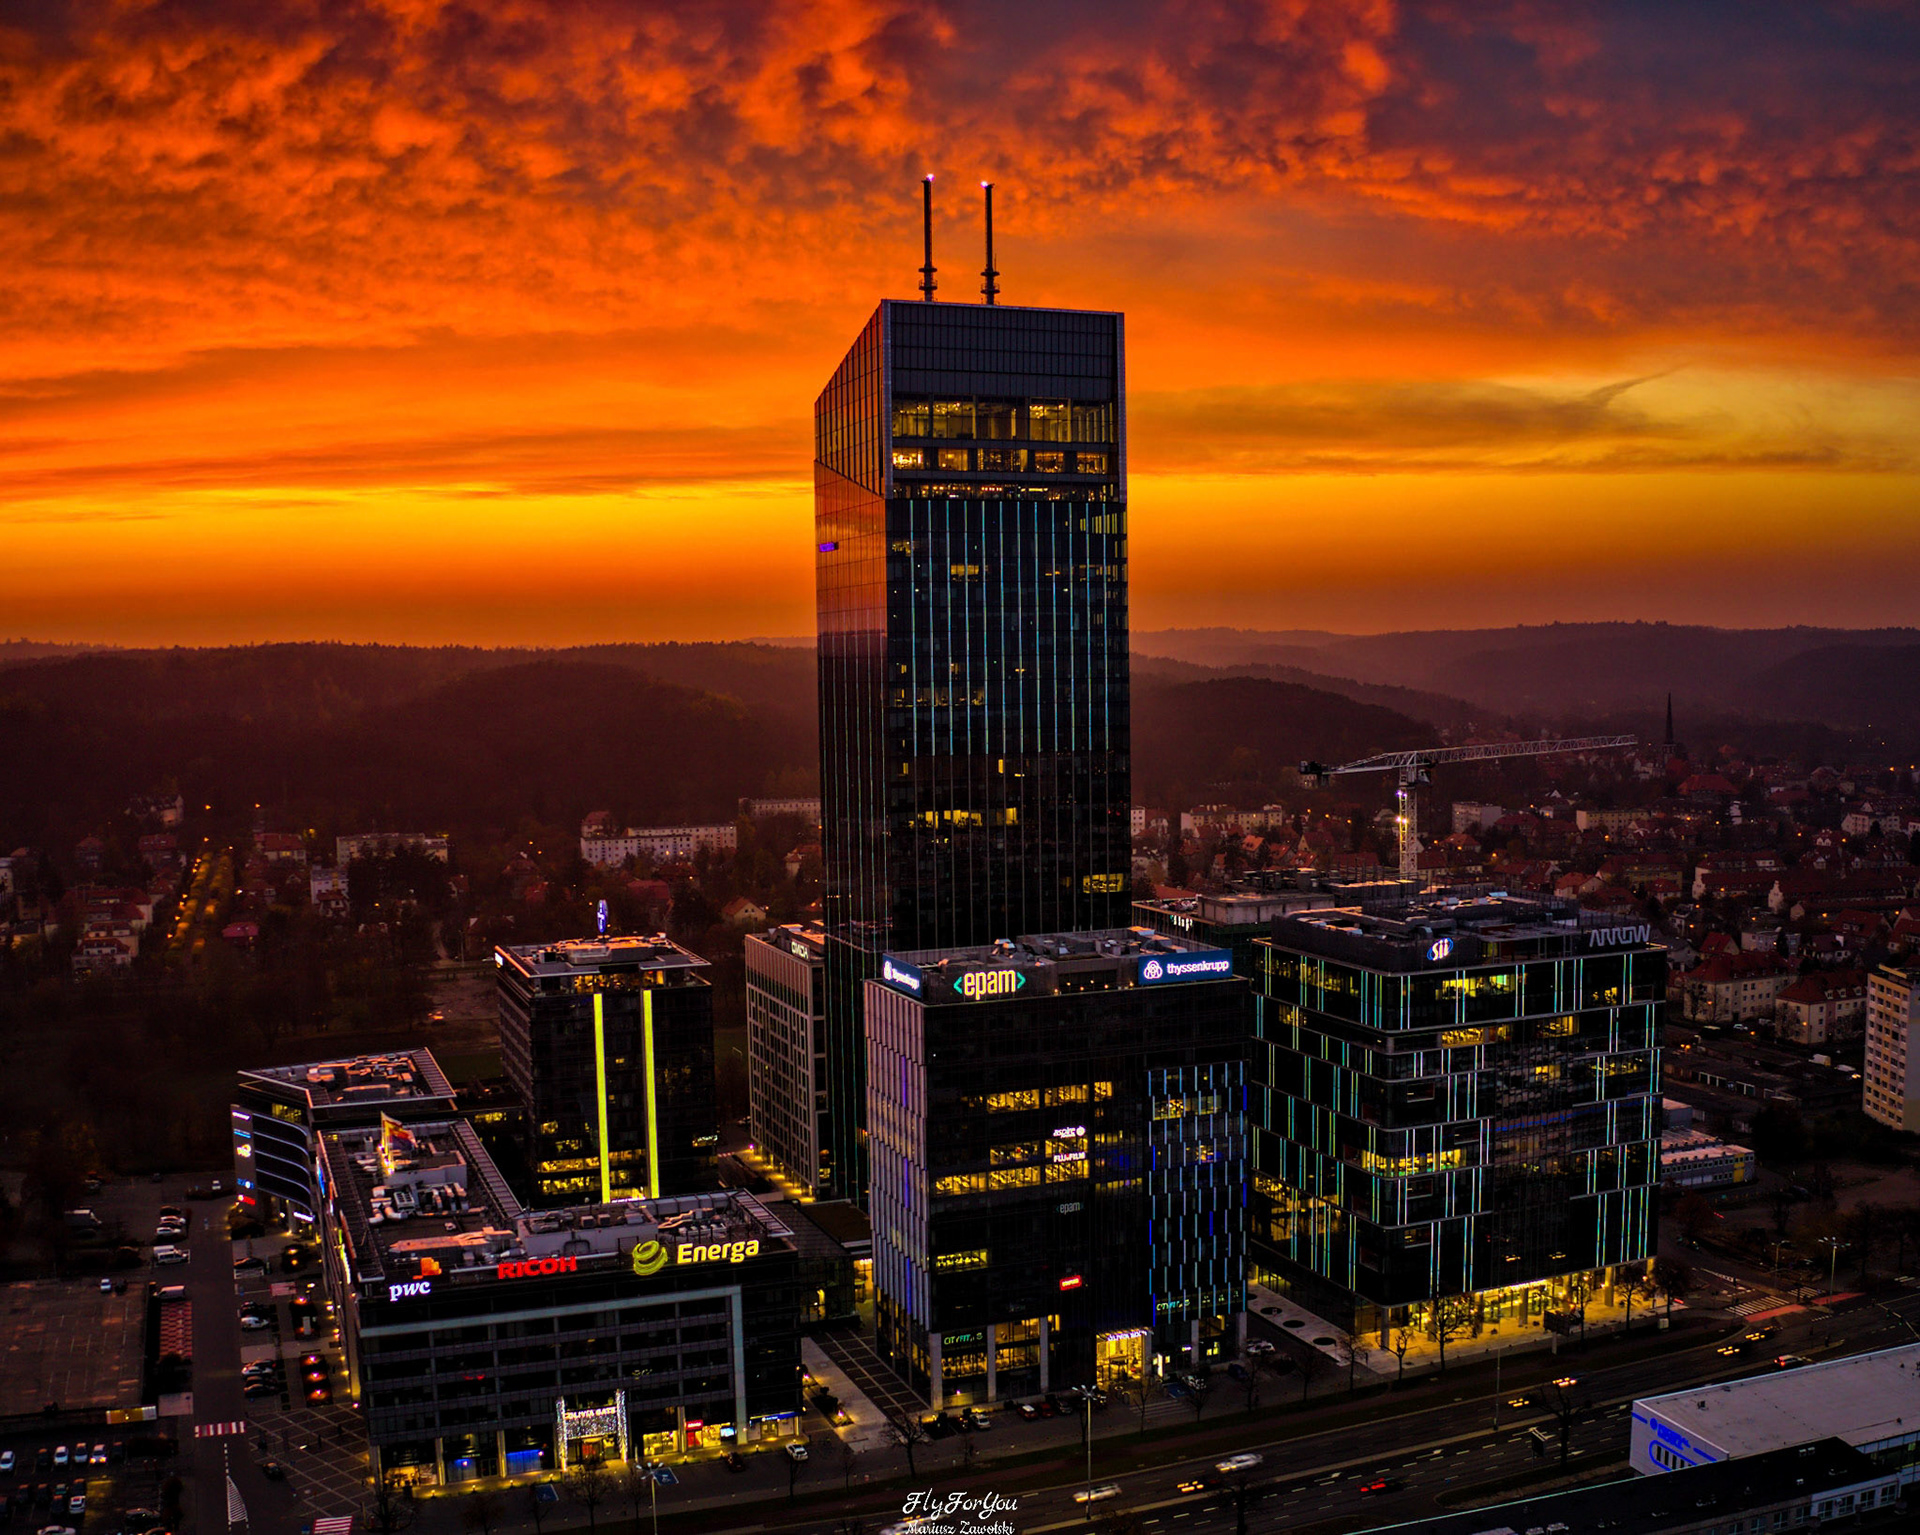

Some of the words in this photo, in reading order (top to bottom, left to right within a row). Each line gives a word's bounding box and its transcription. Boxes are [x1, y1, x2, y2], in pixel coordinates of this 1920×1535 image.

[1589, 925, 1651, 948] ARROW
[1166, 960, 1230, 976] thyssenkrupp
[676, 1239, 760, 1265] Energa
[497, 1255, 578, 1280] RICOH
[389, 1281, 431, 1302] pwc
